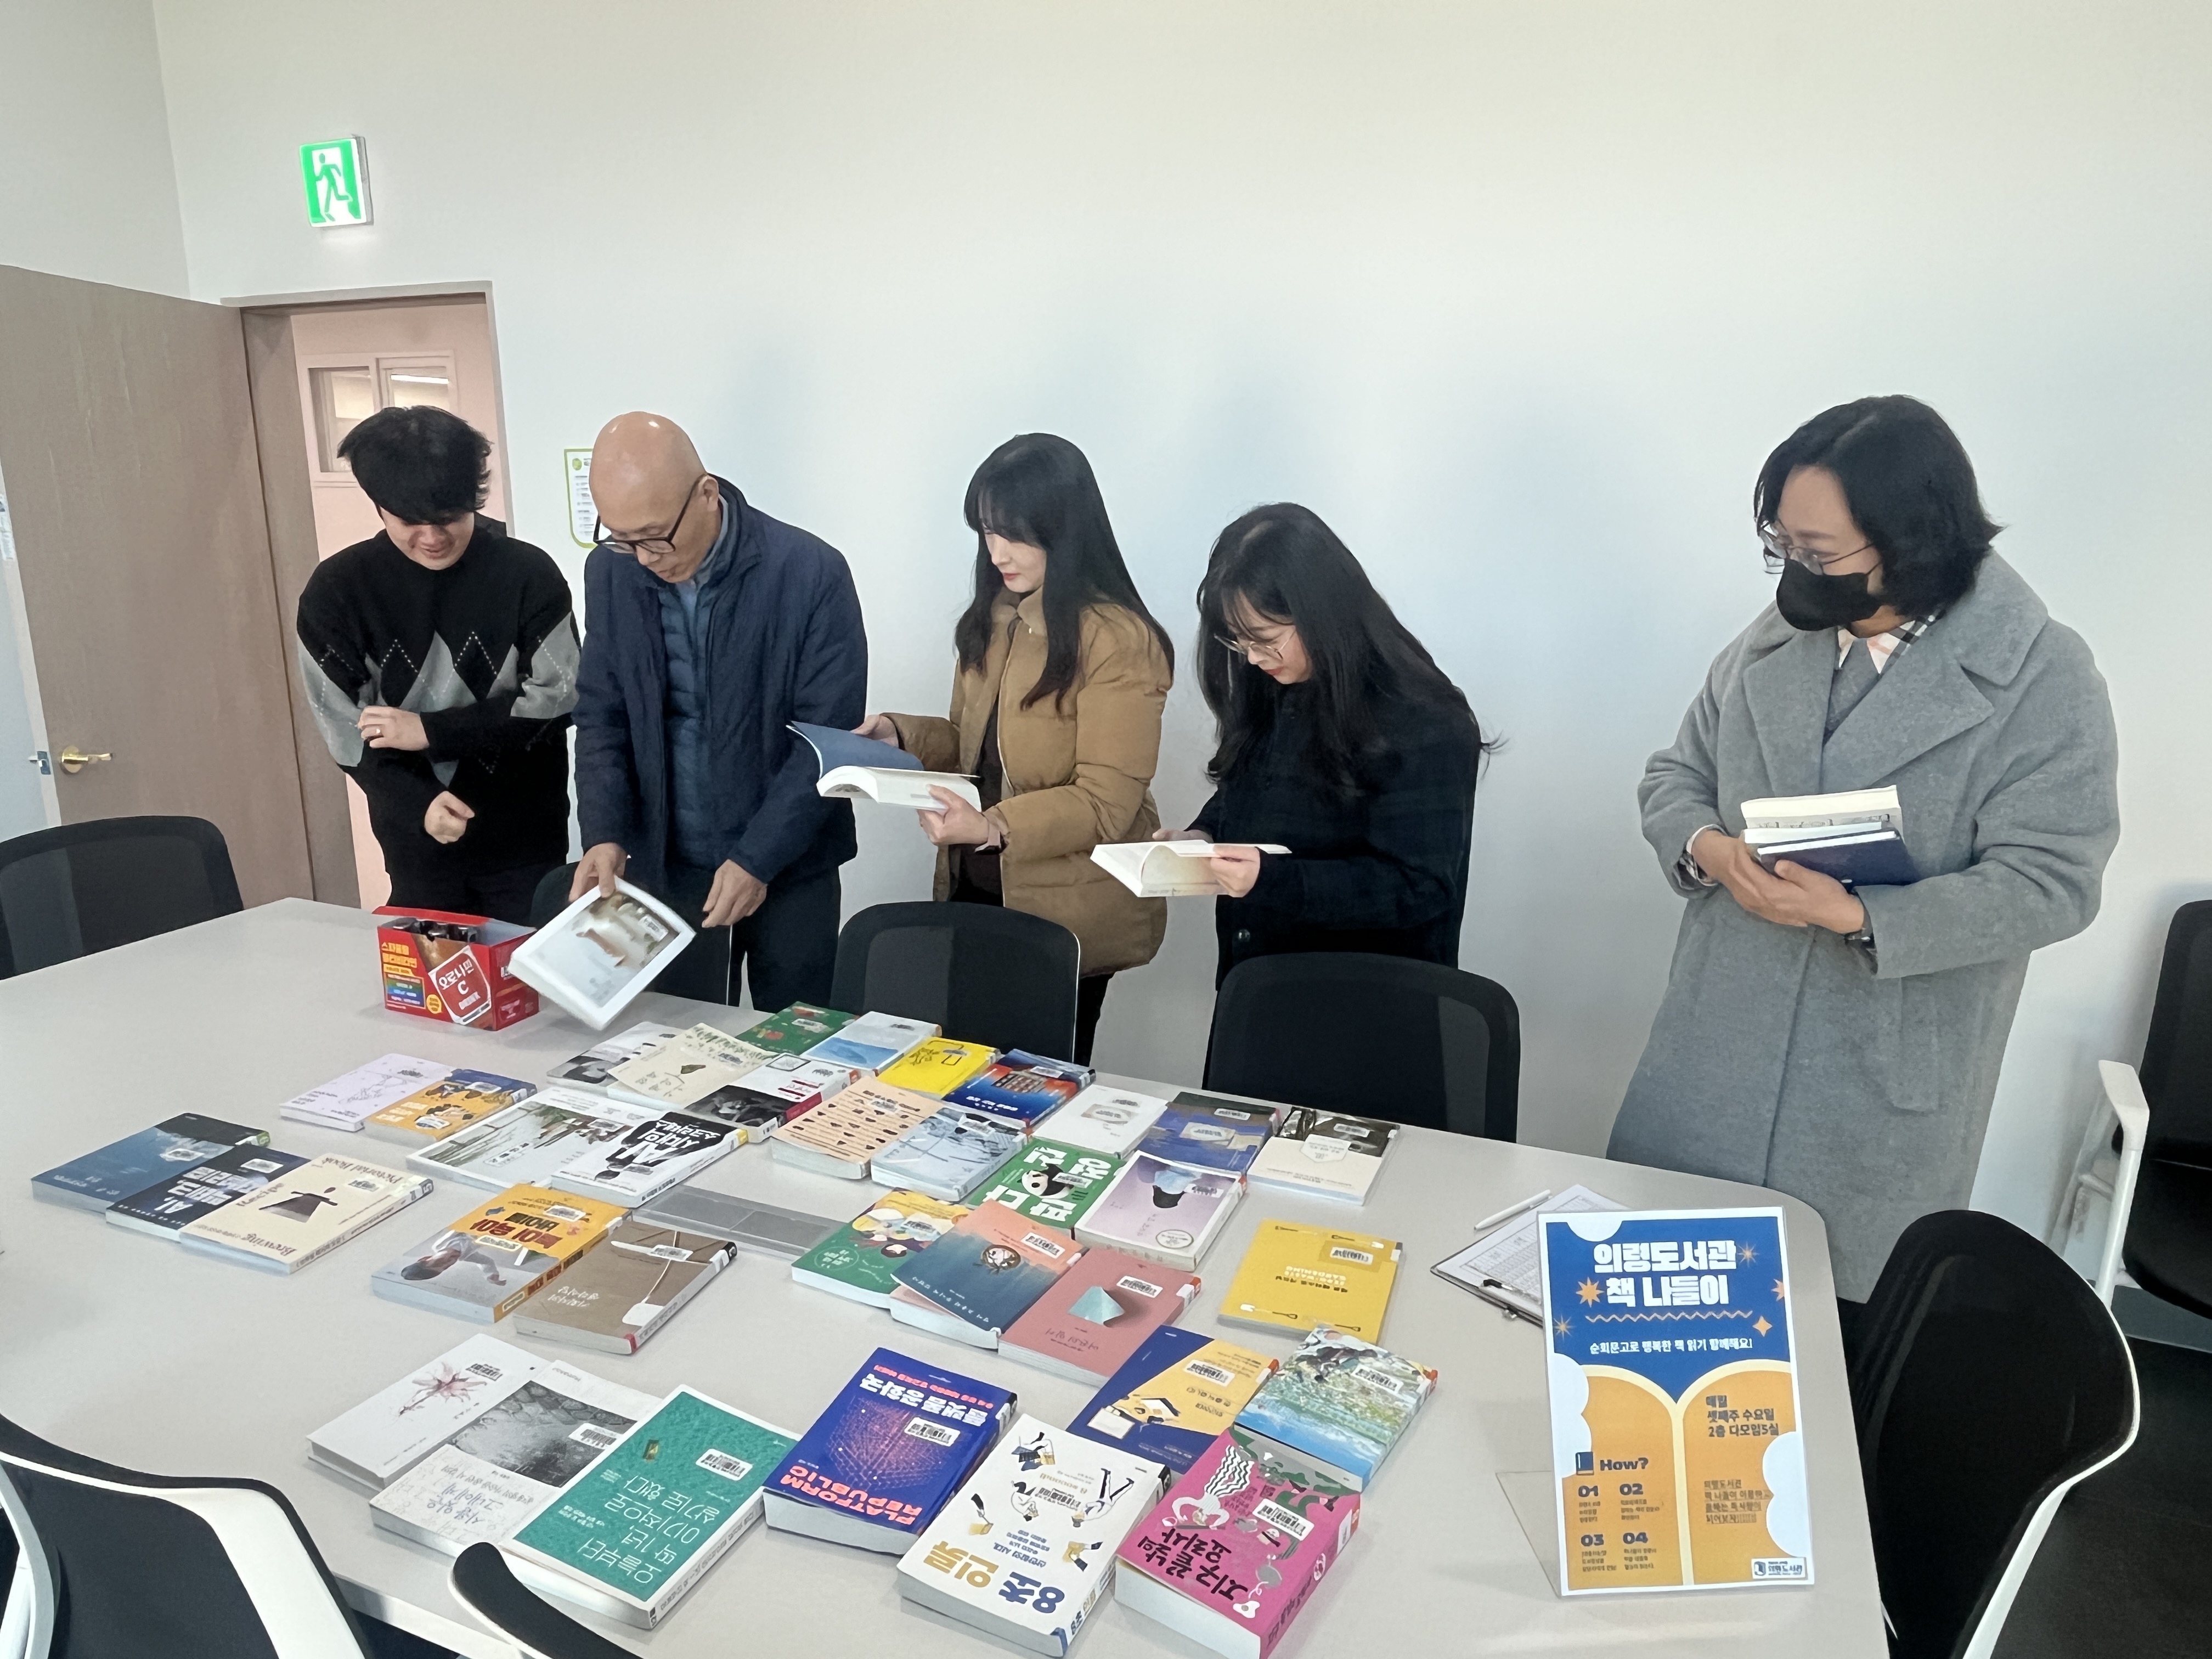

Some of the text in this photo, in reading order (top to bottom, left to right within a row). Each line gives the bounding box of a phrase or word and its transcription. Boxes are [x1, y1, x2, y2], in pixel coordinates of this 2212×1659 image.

[458, 980, 469, 995] C
[613, 1139, 679, 1166] AI
[637, 1128, 699, 1148] 시대의
[154, 1196, 193, 1213] AI,
[241, 1233, 297, 1256] Brewing
[1593, 1240, 1737, 1273] 의령도서관
[1606, 1274, 1729, 1307] 책 나들이
[859, 1373, 924, 1407] 공화국
[1743, 1408, 1774, 1421] 수요일
[1600, 1457, 1649, 1471] How?
[623, 1475, 665, 1500] 했다
[780, 1474, 915, 1525] PLATFORM
[789, 1465, 922, 1515] REPUBLIC
[1578, 1483, 1644, 1497] 01 02
[604, 1493, 699, 1543] 이기적으로
[661, 1491, 719, 1523] 살기로
[654, 1544, 676, 1564] 딱
[1161, 1527, 1232, 1567] 요리사
[1581, 1532, 1648, 1547] 03 04
[577, 1537, 662, 1583] 오늘부터
[923, 1541, 998, 1587] 인류
[1137, 1536, 1248, 1600] 지구 끝 날의
[998, 1571, 1064, 1613] 8초
